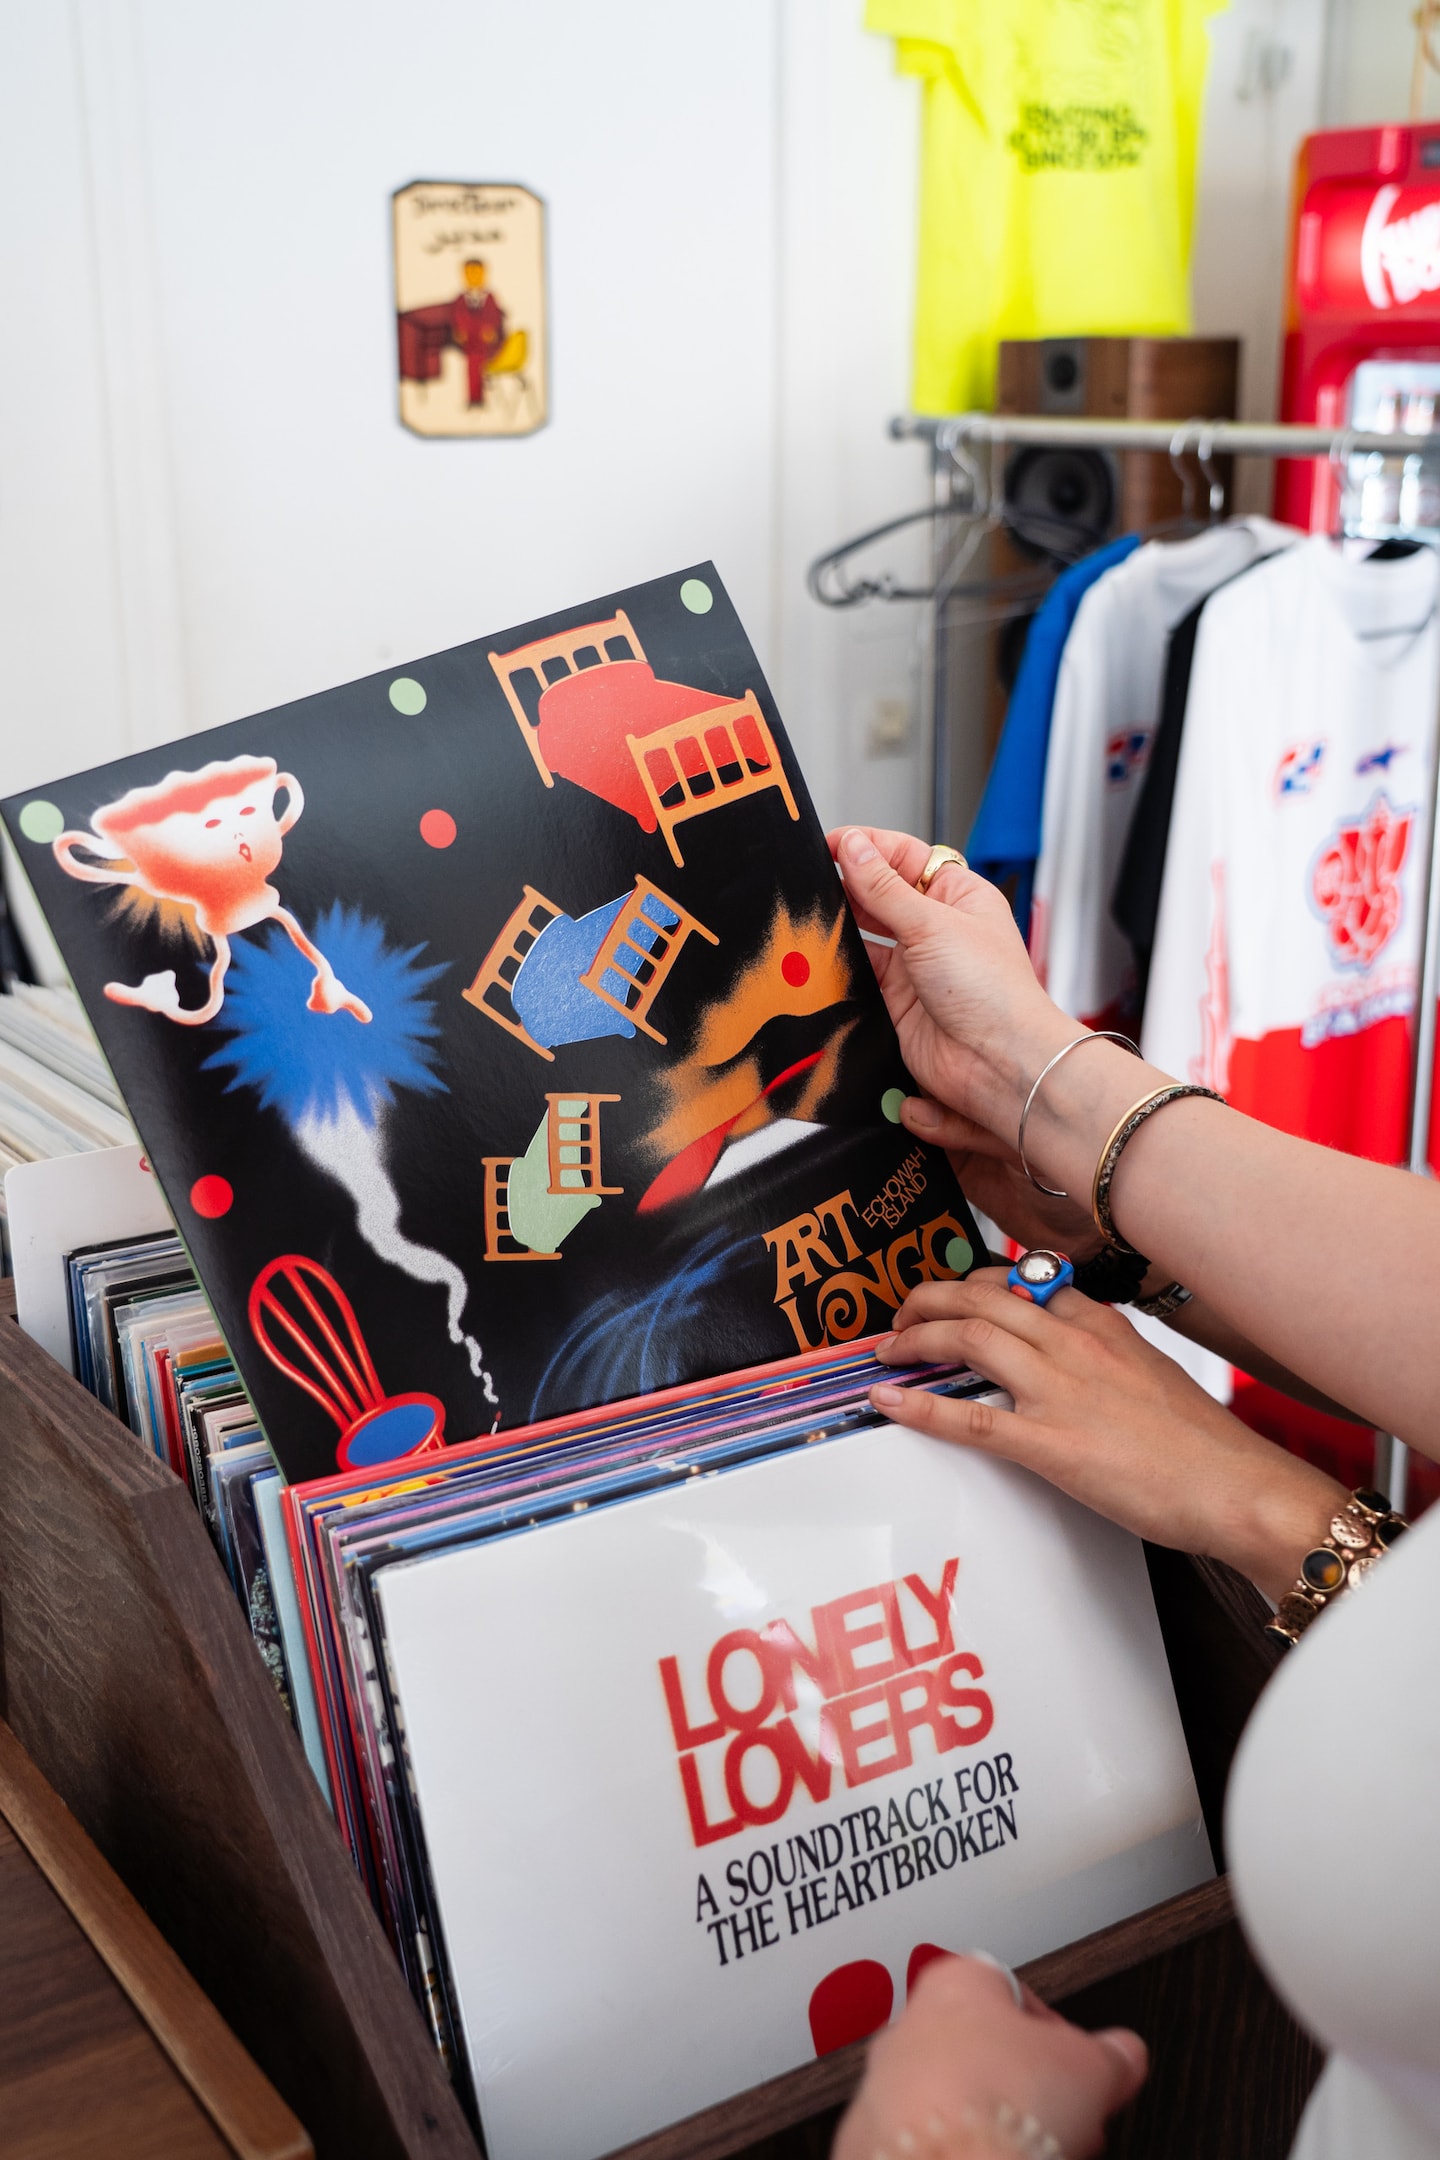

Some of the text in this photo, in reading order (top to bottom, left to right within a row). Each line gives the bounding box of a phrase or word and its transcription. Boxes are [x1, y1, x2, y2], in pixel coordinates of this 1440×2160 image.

[762, 1189, 863, 1304] ART
[861, 1147, 927, 1229] ECHOWAH
[881, 1173, 927, 1229] ISLAND
[779, 1209, 971, 1354] LONGO
[659, 1557, 960, 1752] LONELY
[678, 1652, 994, 1847] LOVERS
[696, 1752, 1020, 1922] A SOUNDTRACK FOR
[707, 1800, 1019, 1966] THE HEARTBROKEN
